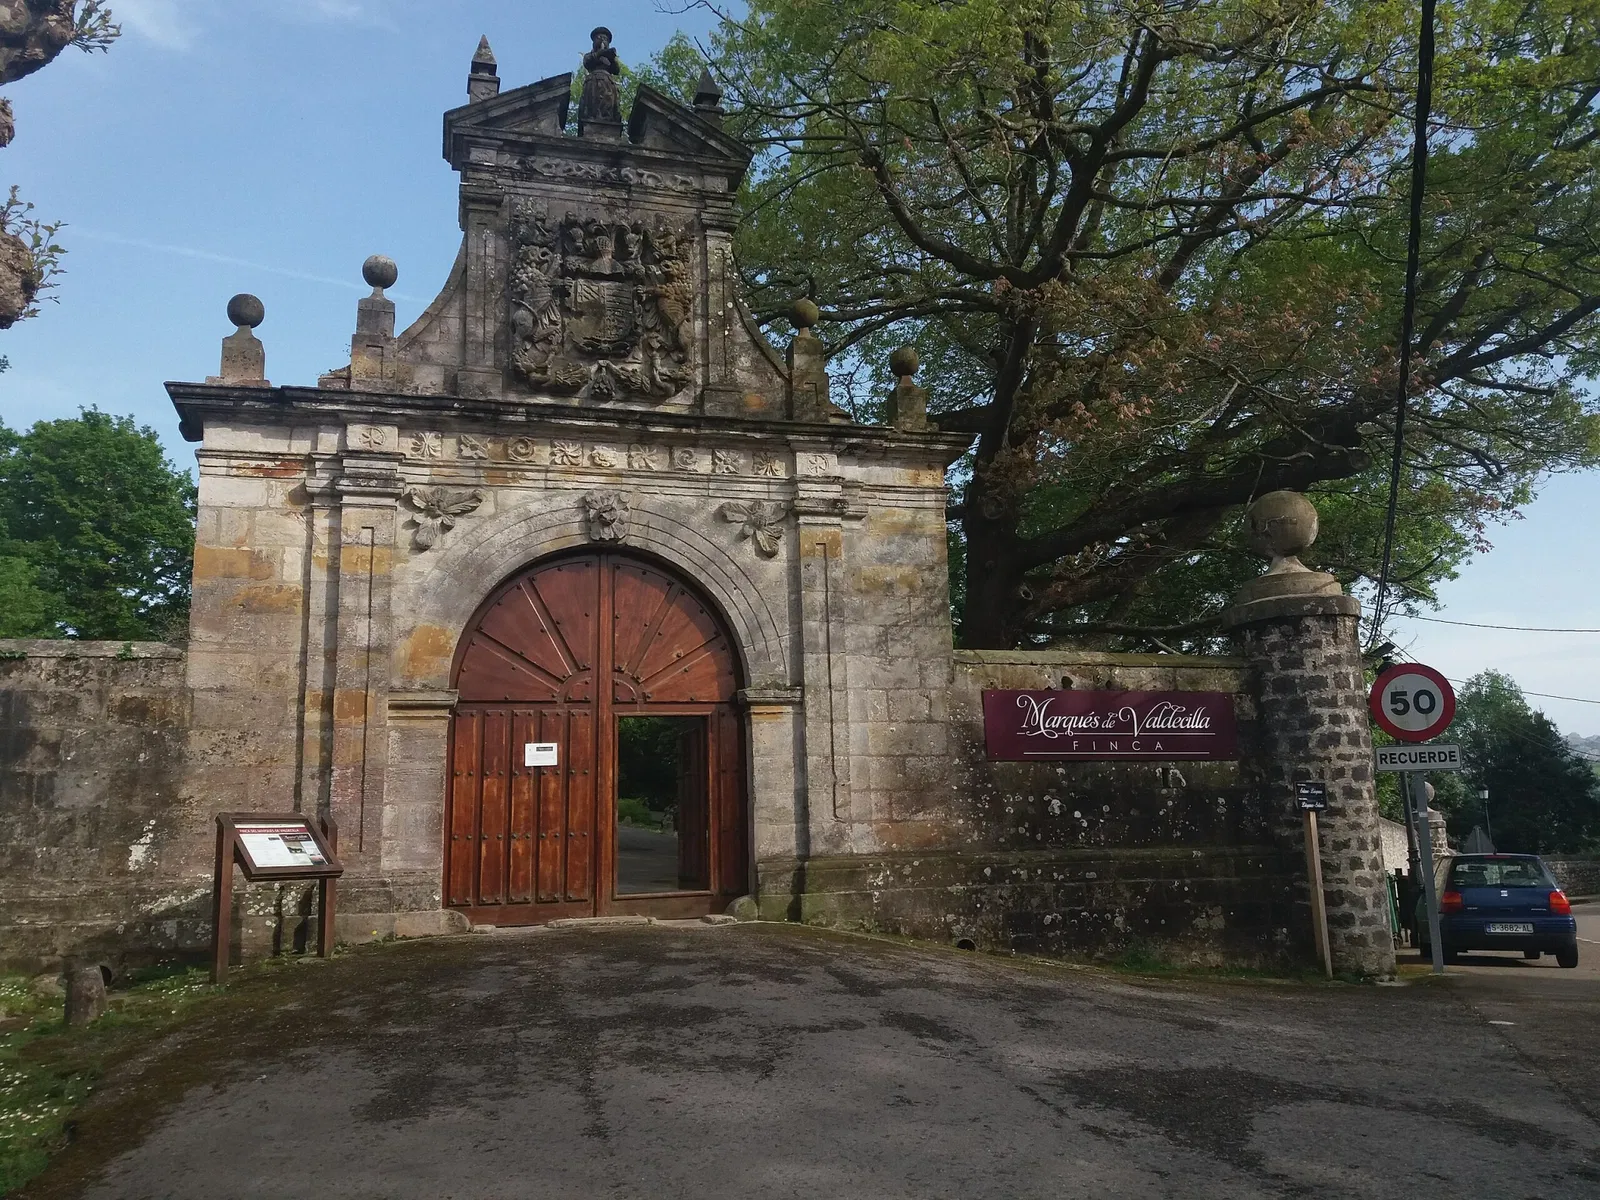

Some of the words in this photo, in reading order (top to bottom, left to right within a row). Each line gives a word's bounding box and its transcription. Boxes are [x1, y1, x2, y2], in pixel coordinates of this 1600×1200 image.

[1390, 689, 1436, 716] 50
[1016, 694, 1101, 739] Marqués
[1101, 712, 1118, 729] de
[1118, 701, 1211, 738] Valdecilla
[1073, 740, 1164, 751] FINCA
[1379, 750, 1458, 765] RECUERDE
